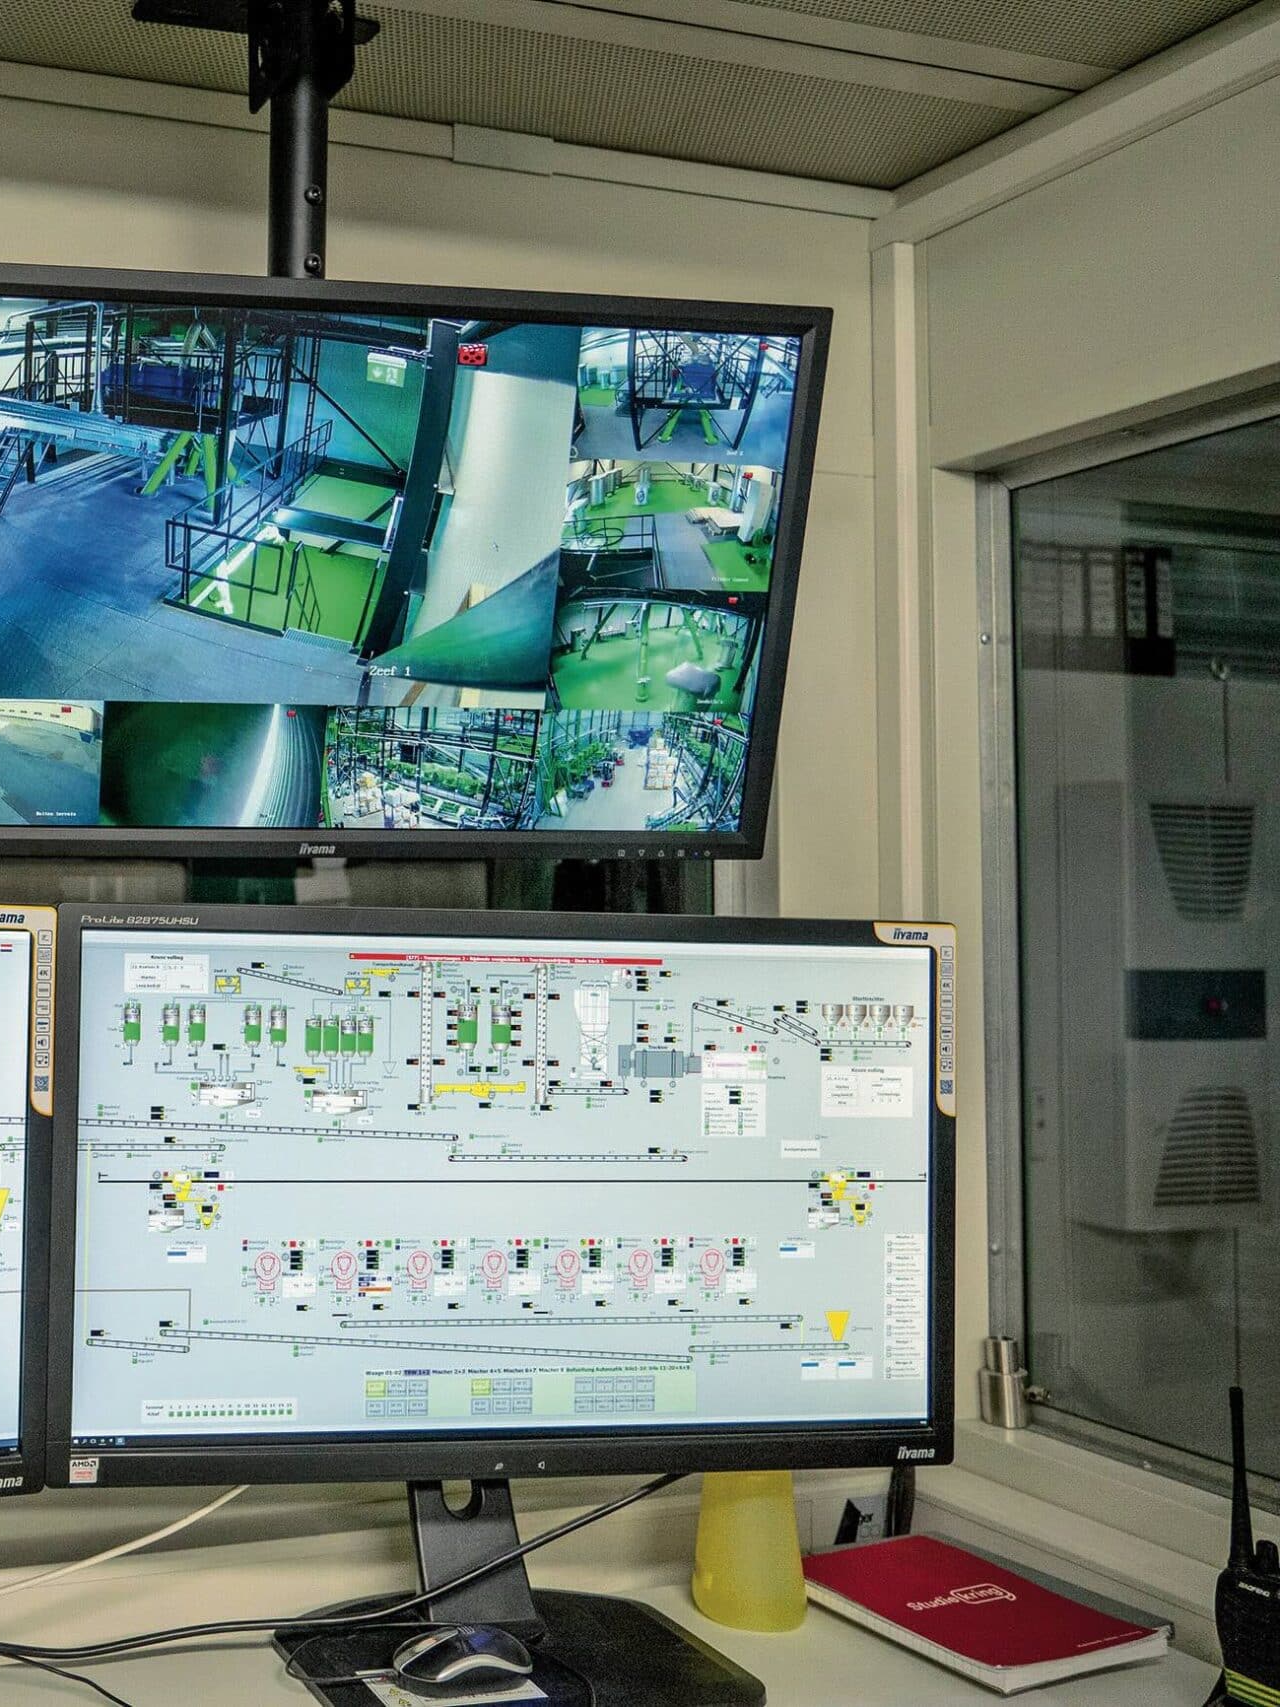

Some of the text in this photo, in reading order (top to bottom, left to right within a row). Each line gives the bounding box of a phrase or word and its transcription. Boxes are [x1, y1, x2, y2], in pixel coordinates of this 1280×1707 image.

[369, 666, 411, 677] Zeef 1
[299, 842, 336, 856] iiyama
[81, 915, 199, 926] ProLite B2875UHSU
[892, 928, 928, 941] iiyama
[897, 1446, 936, 1460] iiyama
